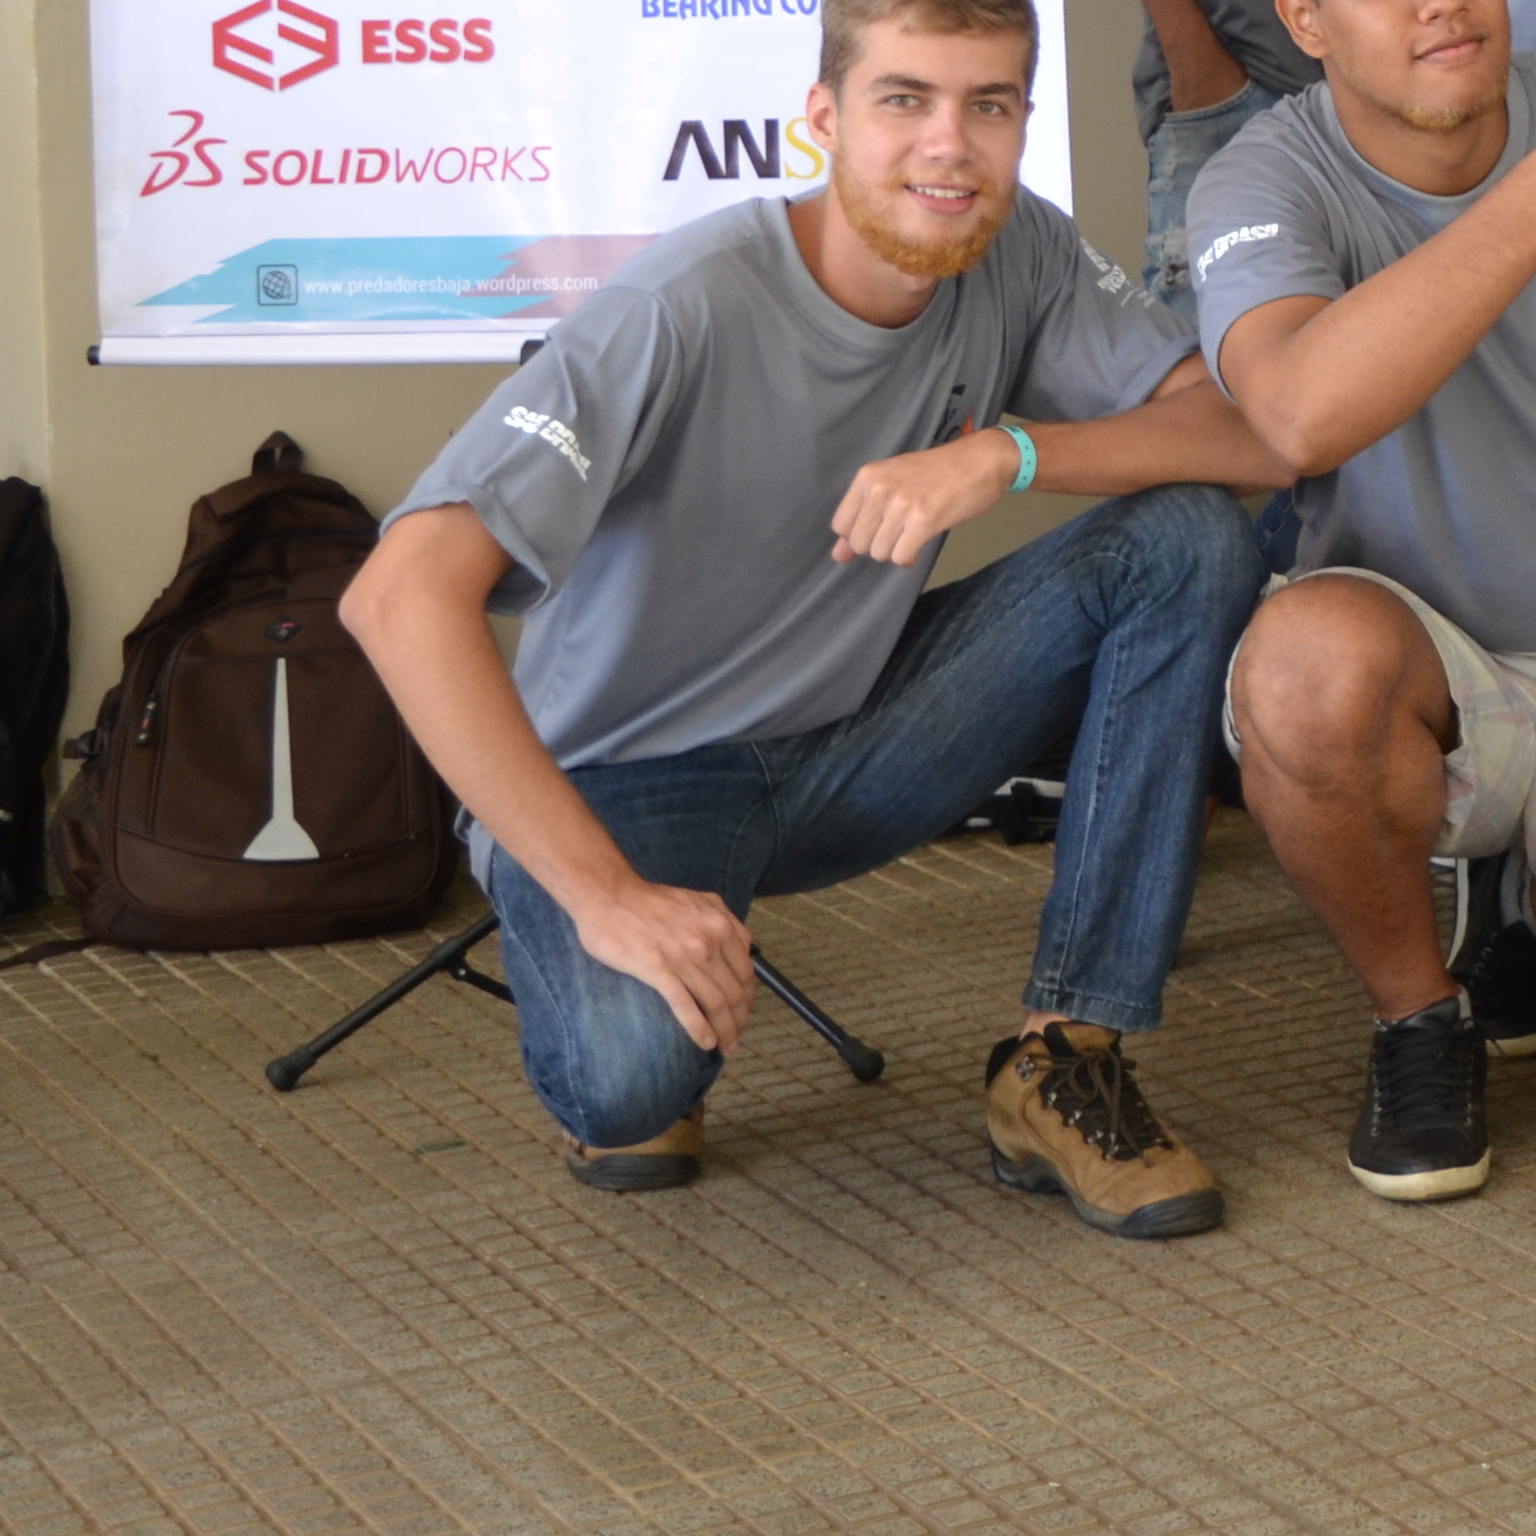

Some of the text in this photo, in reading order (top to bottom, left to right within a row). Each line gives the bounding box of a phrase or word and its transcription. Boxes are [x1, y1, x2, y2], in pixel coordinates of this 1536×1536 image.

[360, 17, 496, 66] ESSS
[241, 145, 554, 187] SOLIDWORKS
[304, 273, 600, 298] www.predadoresbaja.wordpress.com
